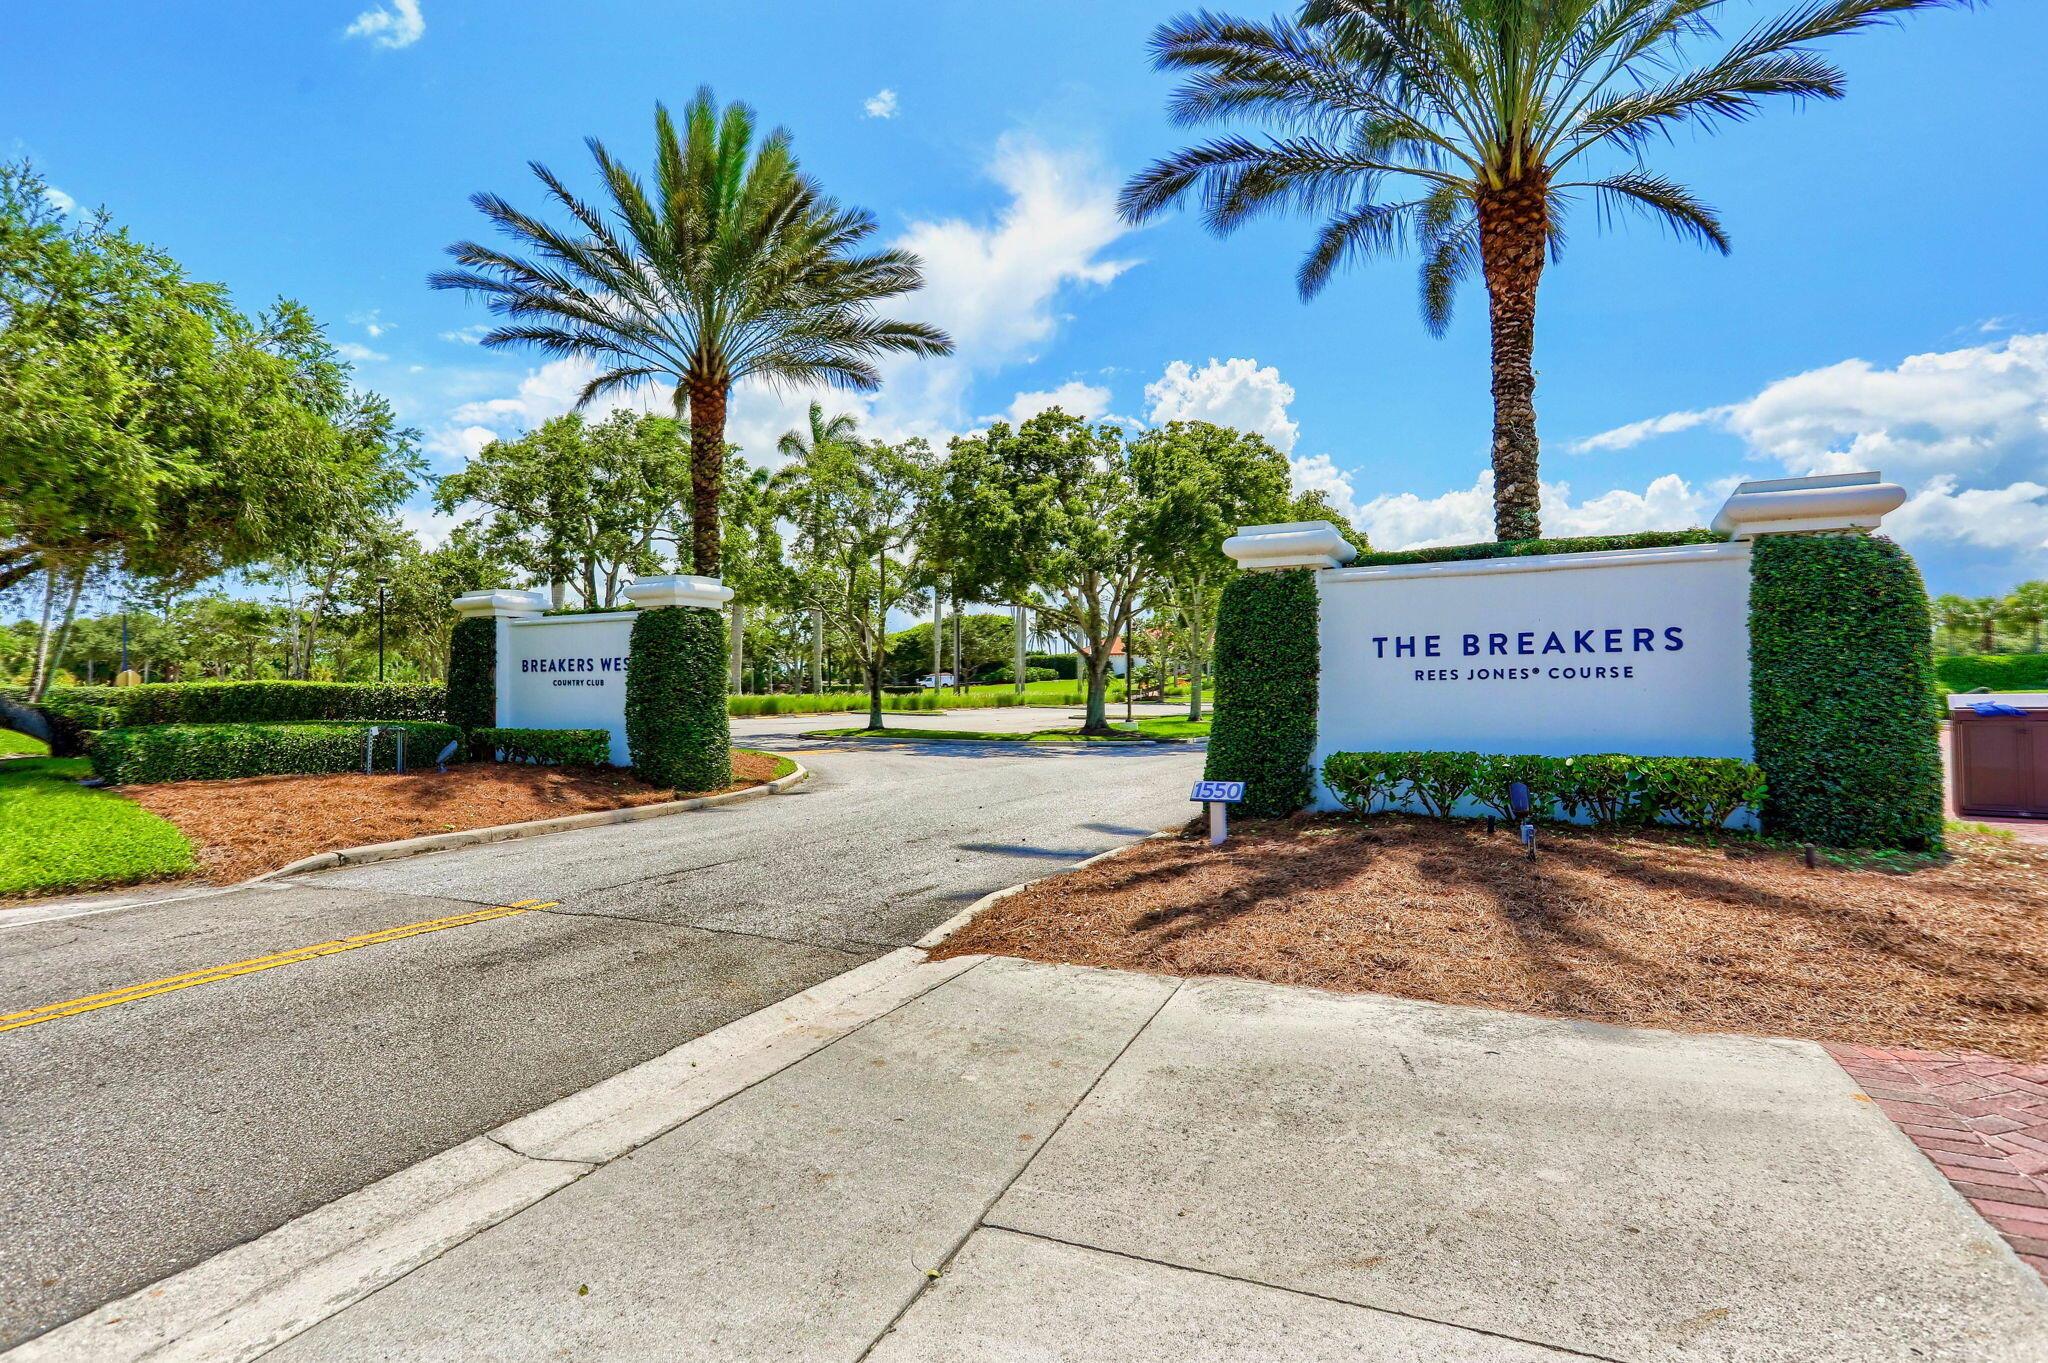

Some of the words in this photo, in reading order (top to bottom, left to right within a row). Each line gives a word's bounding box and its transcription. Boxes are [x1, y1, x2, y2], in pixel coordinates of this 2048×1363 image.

[1372, 635, 1441, 658] THE
[1462, 626, 1684, 656] BREAKERS
[521, 658, 594, 673] BREAKERS
[600, 657, 631, 671] WES
[1415, 669, 1459, 681] REES
[1548, 666, 1634, 679] COURSE
[552, 679, 585, 687] COUNTRY
[586, 679, 605, 687] CLUB
[1195, 782, 1241, 799] 1550
